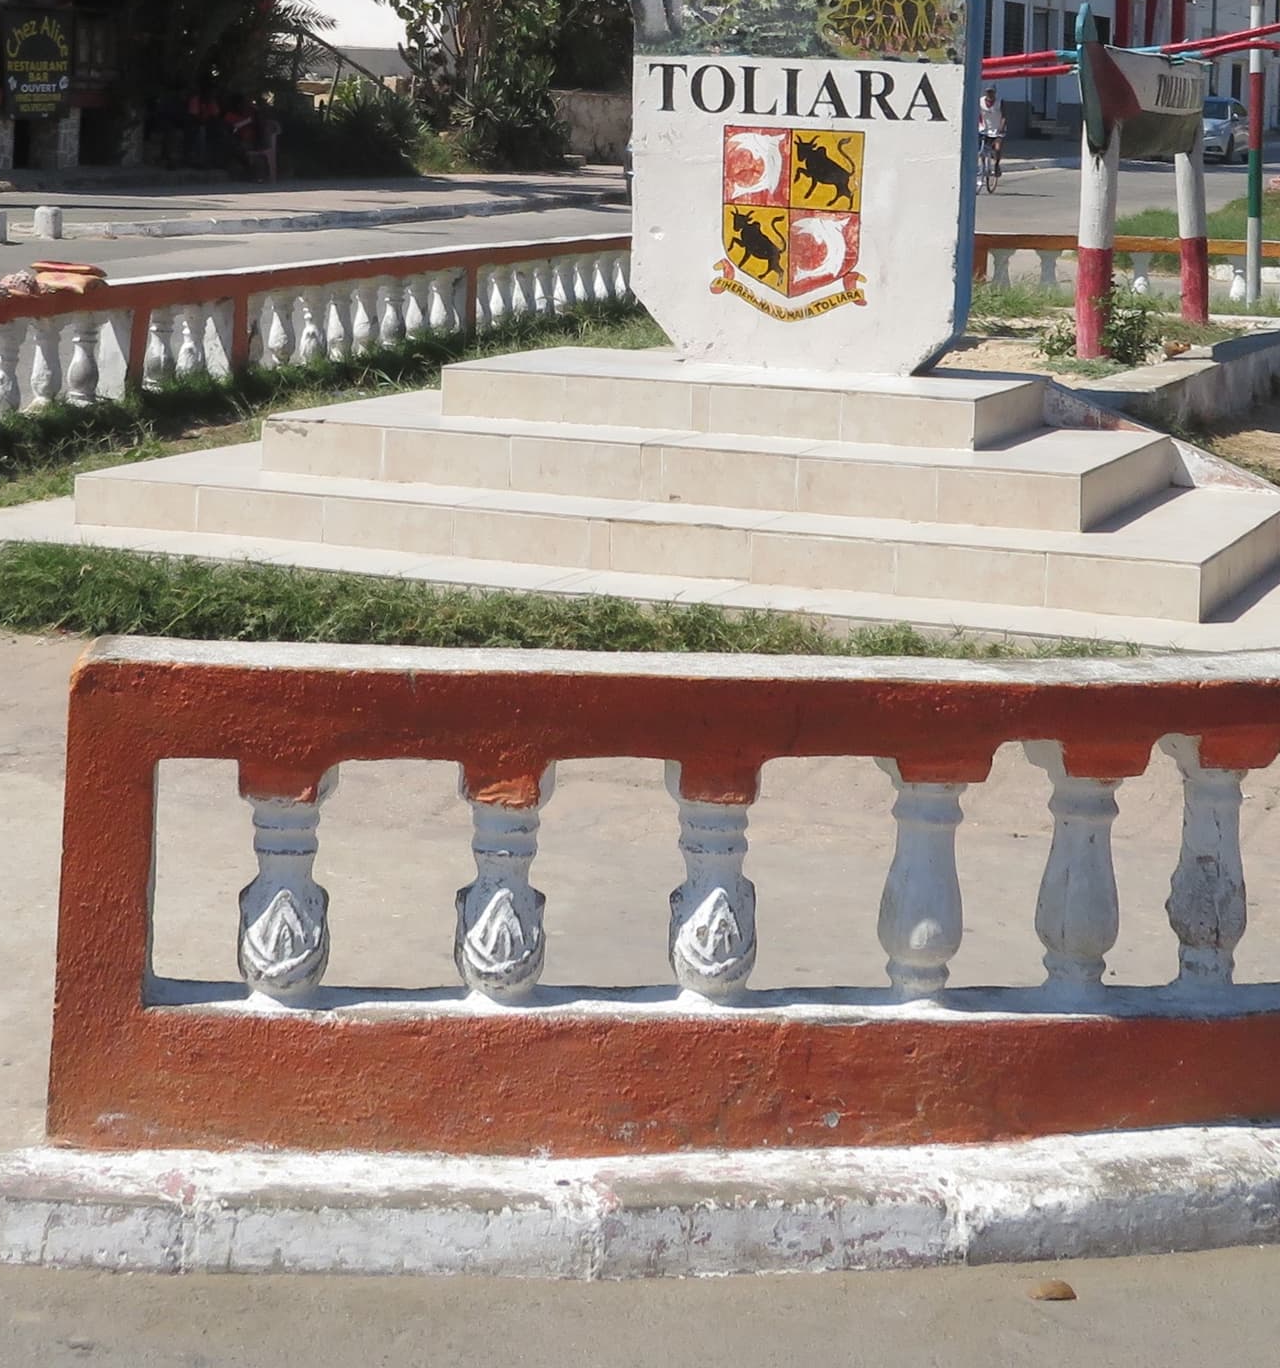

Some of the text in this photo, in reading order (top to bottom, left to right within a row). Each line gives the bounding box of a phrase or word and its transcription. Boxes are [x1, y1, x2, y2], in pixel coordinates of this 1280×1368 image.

[6, 15, 69, 59] Chez Alice
[7, 60, 68, 72] RESTAURANT
[28, 72, 49, 82] BAR
[20, 83, 57, 93] OUVERT
[649, 62, 948, 122] TOLIARA
